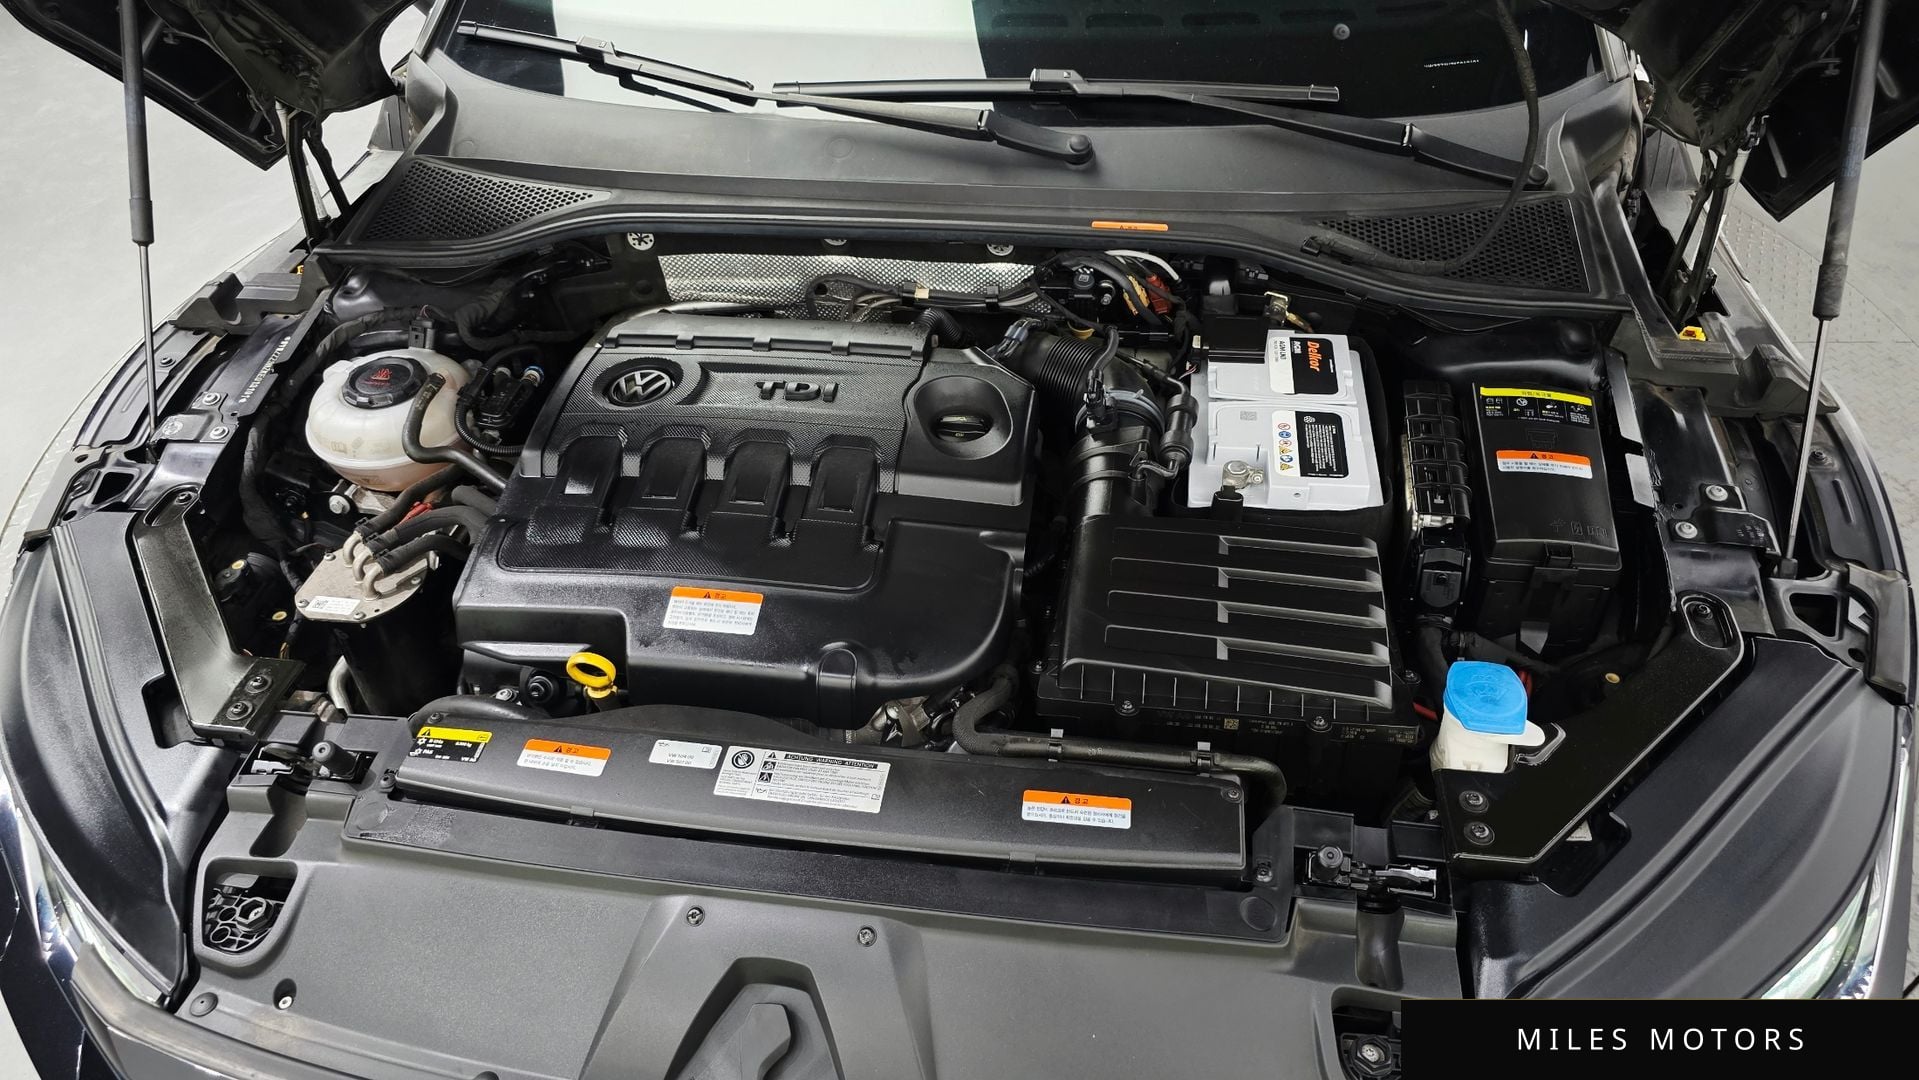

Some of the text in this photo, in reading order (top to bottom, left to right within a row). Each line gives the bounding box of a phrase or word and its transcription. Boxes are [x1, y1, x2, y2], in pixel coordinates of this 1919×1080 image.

[1307, 340, 1322, 372] Delkor
[754, 380, 840, 402] TDI
[786, 754, 815, 763] ACHTUNG
[816, 757, 843, 765] WARNING
[844, 761, 876, 769] ATTENTION
